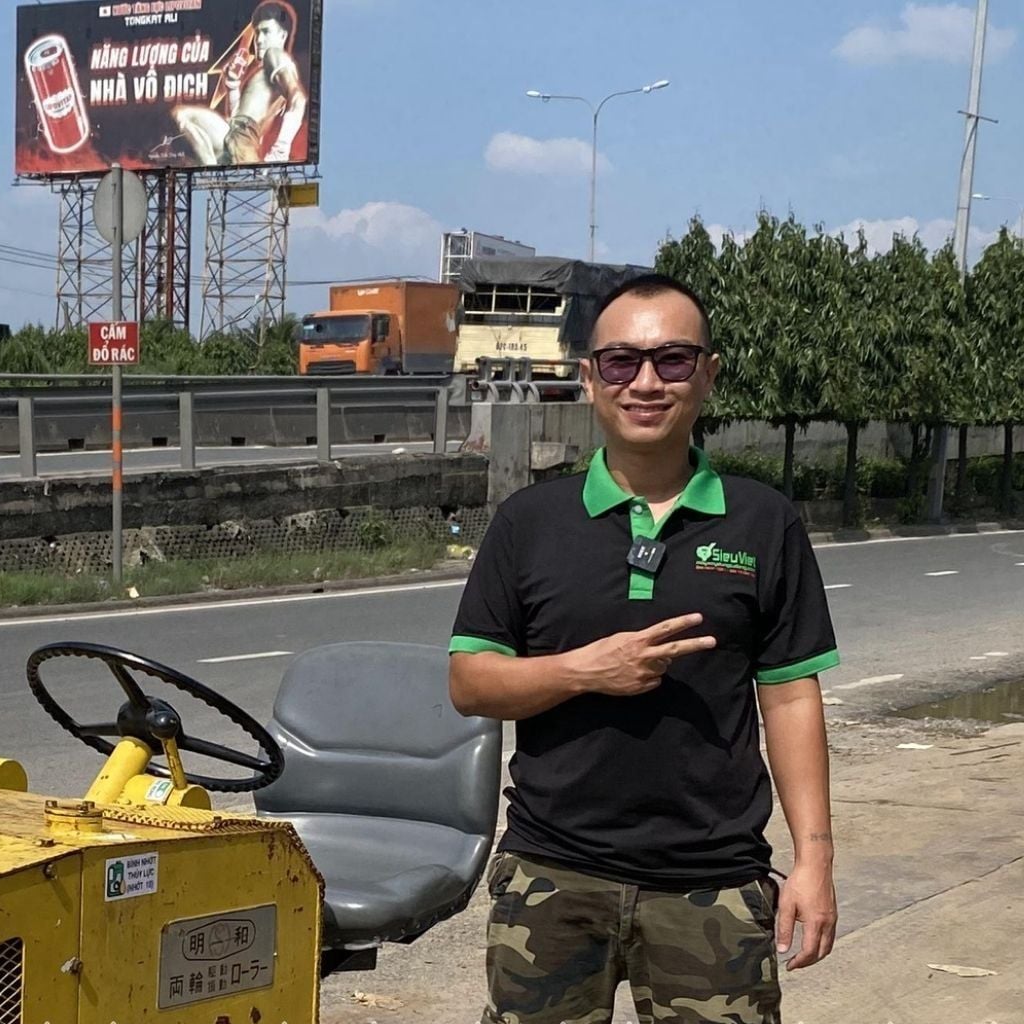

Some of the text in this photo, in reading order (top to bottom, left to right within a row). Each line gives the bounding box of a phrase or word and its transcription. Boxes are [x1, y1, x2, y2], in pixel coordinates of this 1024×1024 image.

[124, 13, 178, 26] TONGKAT ALI
[90, 35, 210, 70] NĂNG LƯỢNG CỦA
[90, 72, 127, 103] NHÀ
[133, 69, 158, 100] VÔ
[100, 321, 127, 340] CẤM
[93, 340, 135, 361] ĐỔ RÁC
